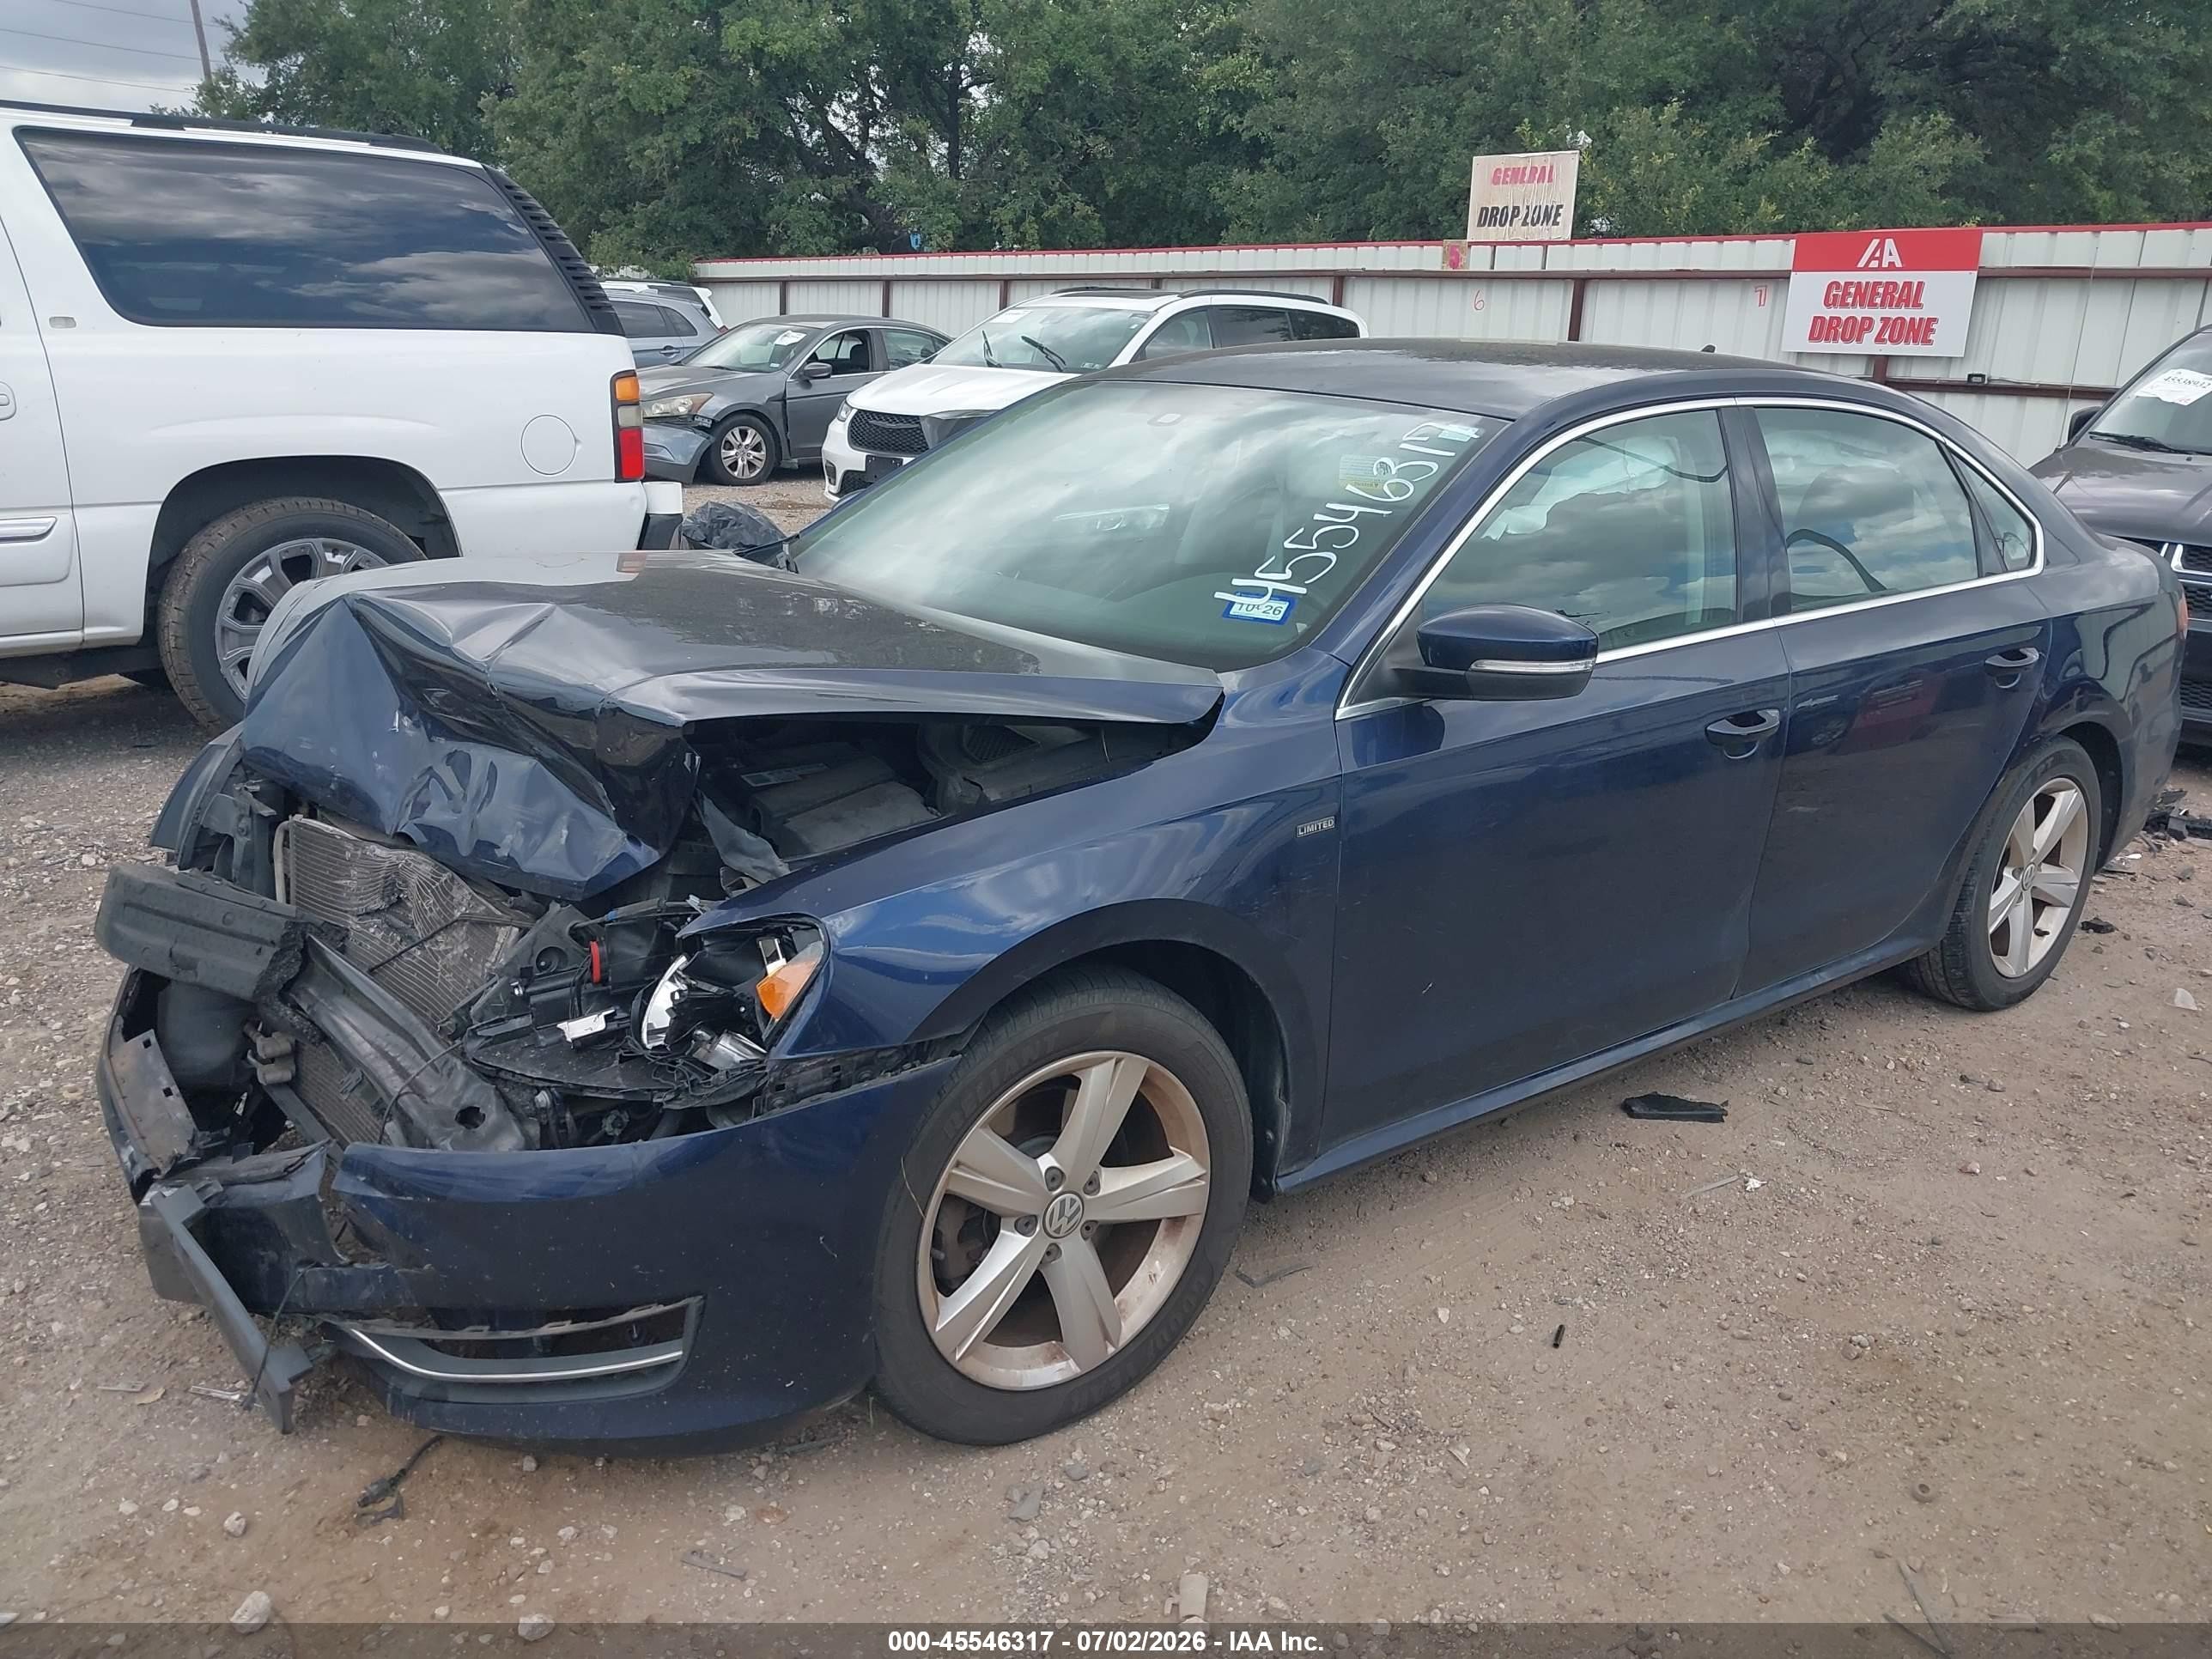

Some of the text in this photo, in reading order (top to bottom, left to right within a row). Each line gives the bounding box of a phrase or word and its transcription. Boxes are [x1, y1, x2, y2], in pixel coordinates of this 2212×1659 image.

[1492, 164, 1553, 185] GENERAL
[1477, 204, 1564, 228] DROP ZONE
[1474, 289, 1485, 311] 6
[1823, 281, 1925, 310] GENERAL
[1808, 315, 1938, 345] DROP ZONE
[1262, 605, 1284, 616] 26
[1297, 819, 1334, 835] LIMITED
